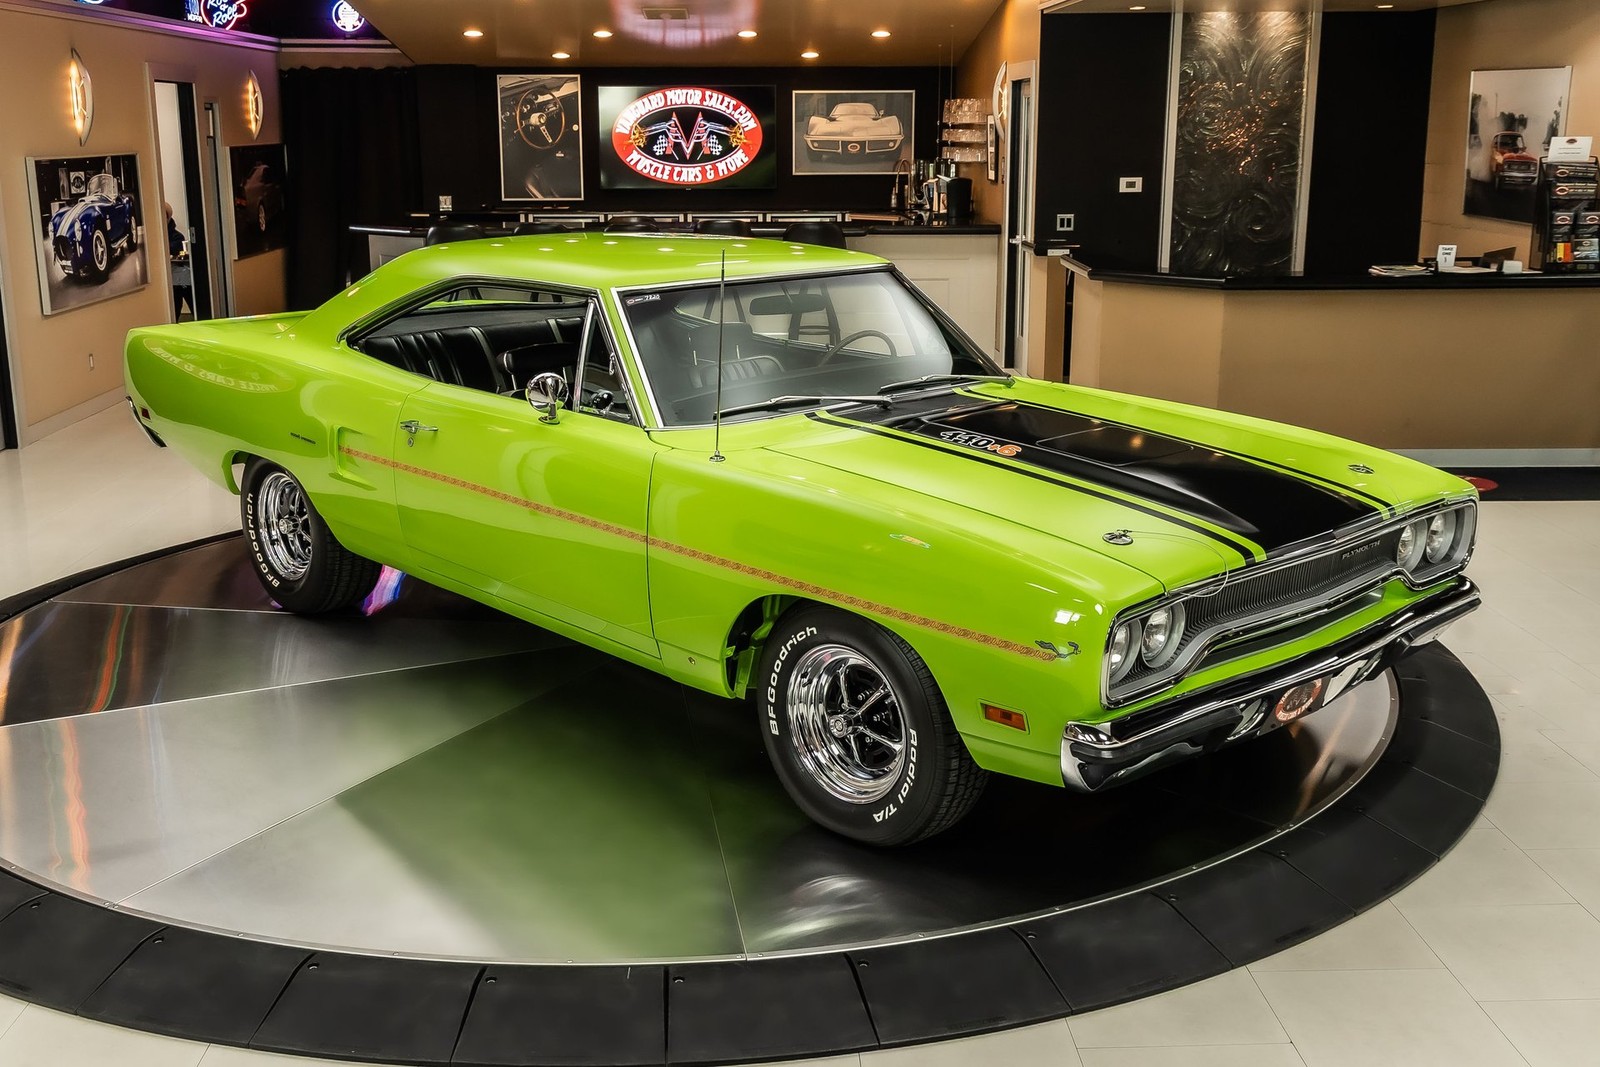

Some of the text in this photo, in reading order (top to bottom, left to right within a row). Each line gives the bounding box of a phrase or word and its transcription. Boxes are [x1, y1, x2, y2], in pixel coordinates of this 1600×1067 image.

[213, 4, 238, 27] Roll
[615, 88, 757, 135] VANGUARD MOTOR SALES.COM
[625, 149, 749, 182] MUSCLE CARS & MORE
[246, 493, 280, 588] BFGoodrich
[1342, 540, 1380, 560] PLYMOUTH
[767, 626, 818, 736] BFGoodrich
[872, 728, 918, 823] Radial T/A
